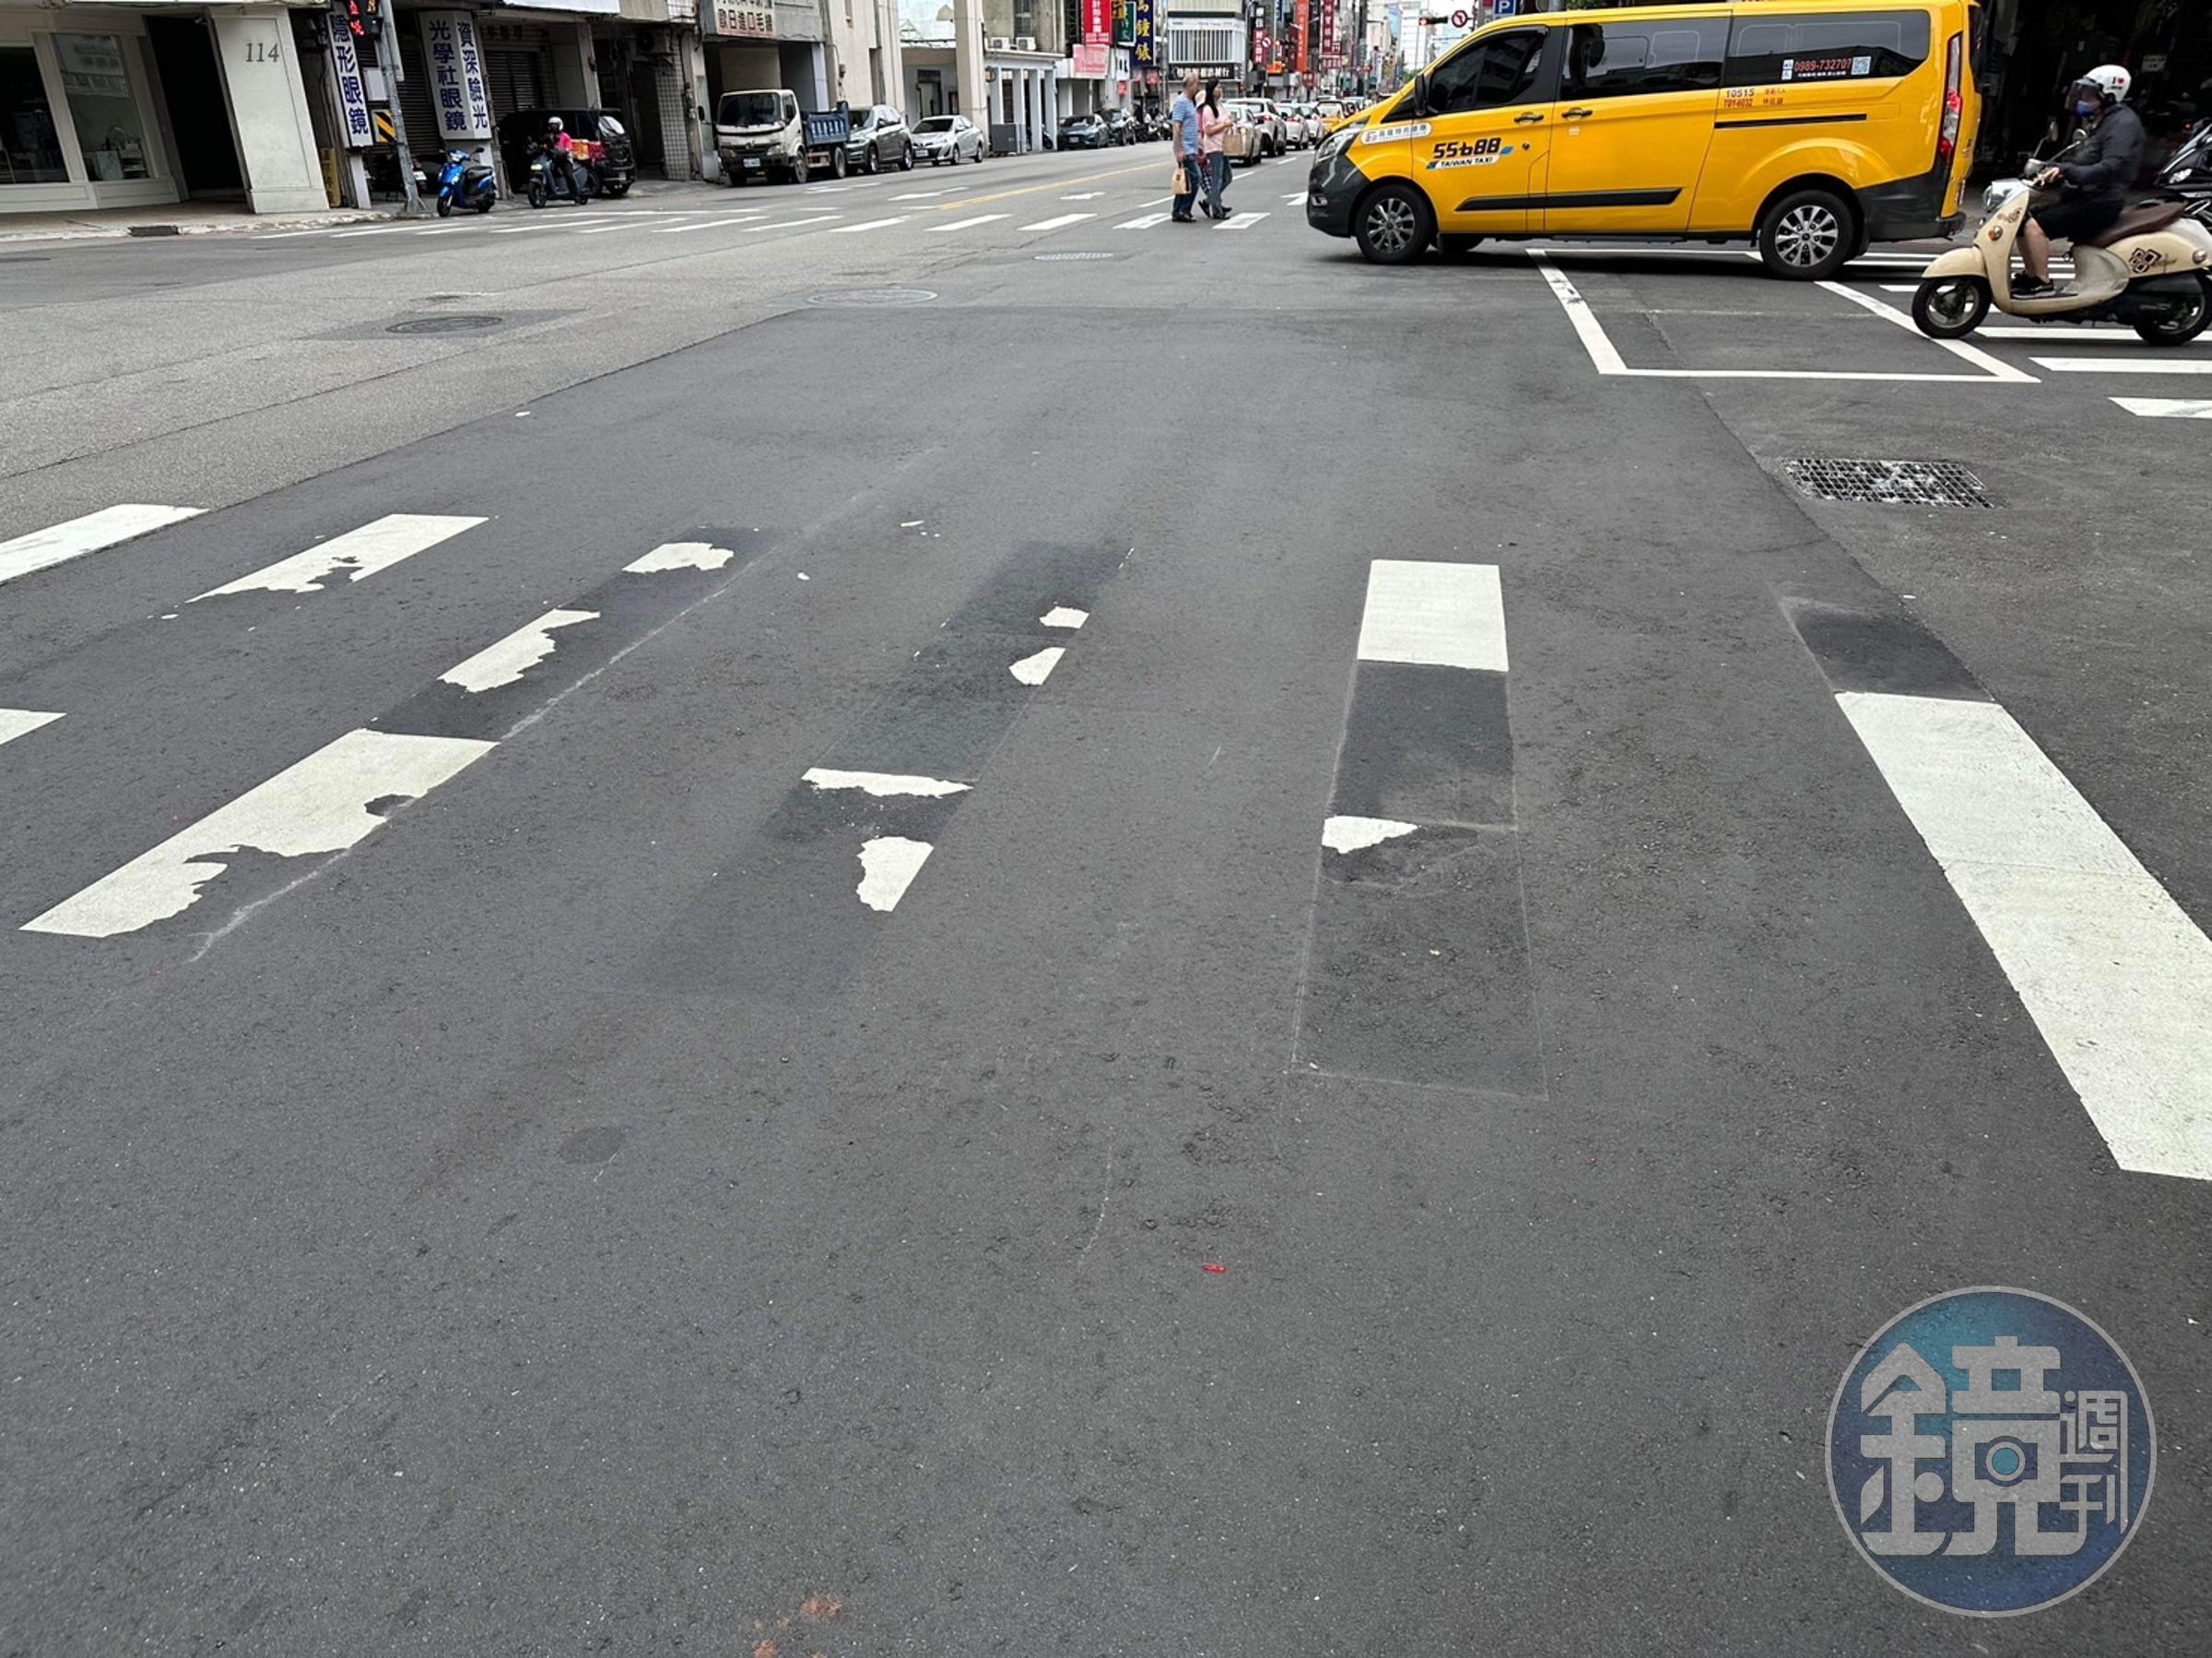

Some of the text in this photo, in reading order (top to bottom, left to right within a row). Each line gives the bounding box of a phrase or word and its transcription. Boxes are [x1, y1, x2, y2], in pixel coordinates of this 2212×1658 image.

[1499, 0, 1511, 13] P
[245, 42, 279, 62] 114
[332, 15, 368, 135] 隱形眼鏡
[429, 19, 467, 131] 光學社眼鏡
[1794, 58, 1852, 72] 0989-732707
[457, 22, 488, 129] 資深驗光
[1726, 88, 1755, 98] 10515
[1433, 137, 1501, 159] 55688
[1441, 159, 1472, 167] TAIWAN
